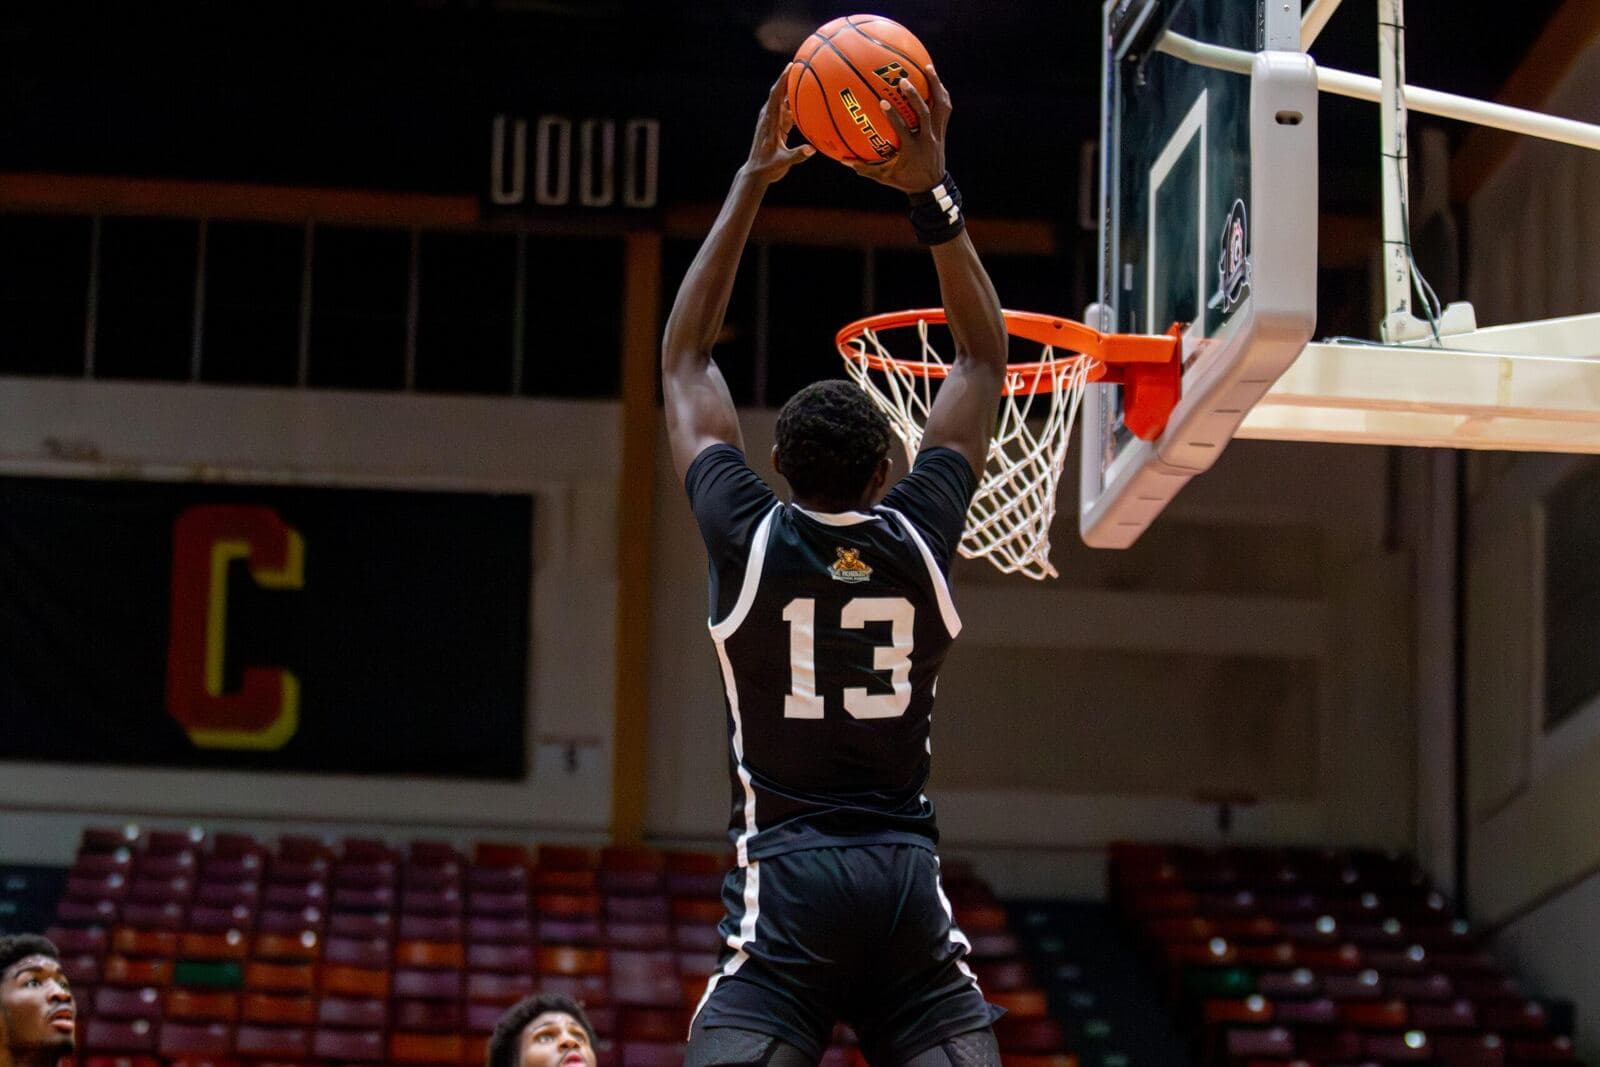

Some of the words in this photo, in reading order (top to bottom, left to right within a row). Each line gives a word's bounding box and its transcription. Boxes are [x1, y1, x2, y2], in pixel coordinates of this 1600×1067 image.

[839, 87, 890, 153] ELITE
[165, 504, 305, 749] C
[782, 597, 915, 720] 13
